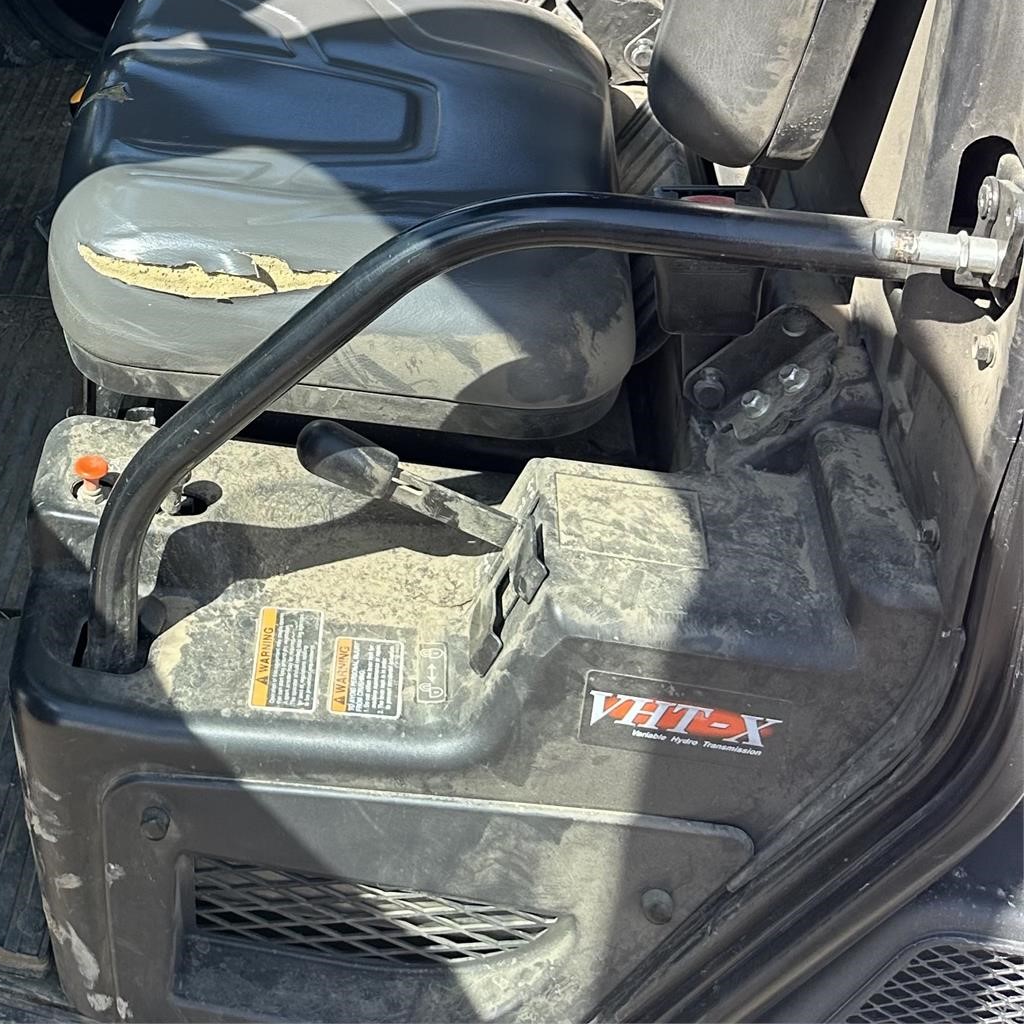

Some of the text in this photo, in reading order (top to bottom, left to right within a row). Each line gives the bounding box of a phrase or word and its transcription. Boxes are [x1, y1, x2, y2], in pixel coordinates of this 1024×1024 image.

[259, 627, 274, 673] WARNING
[334, 645, 351, 689] WARNING
[631, 729, 763, 756] Variable Hydro Transmission
